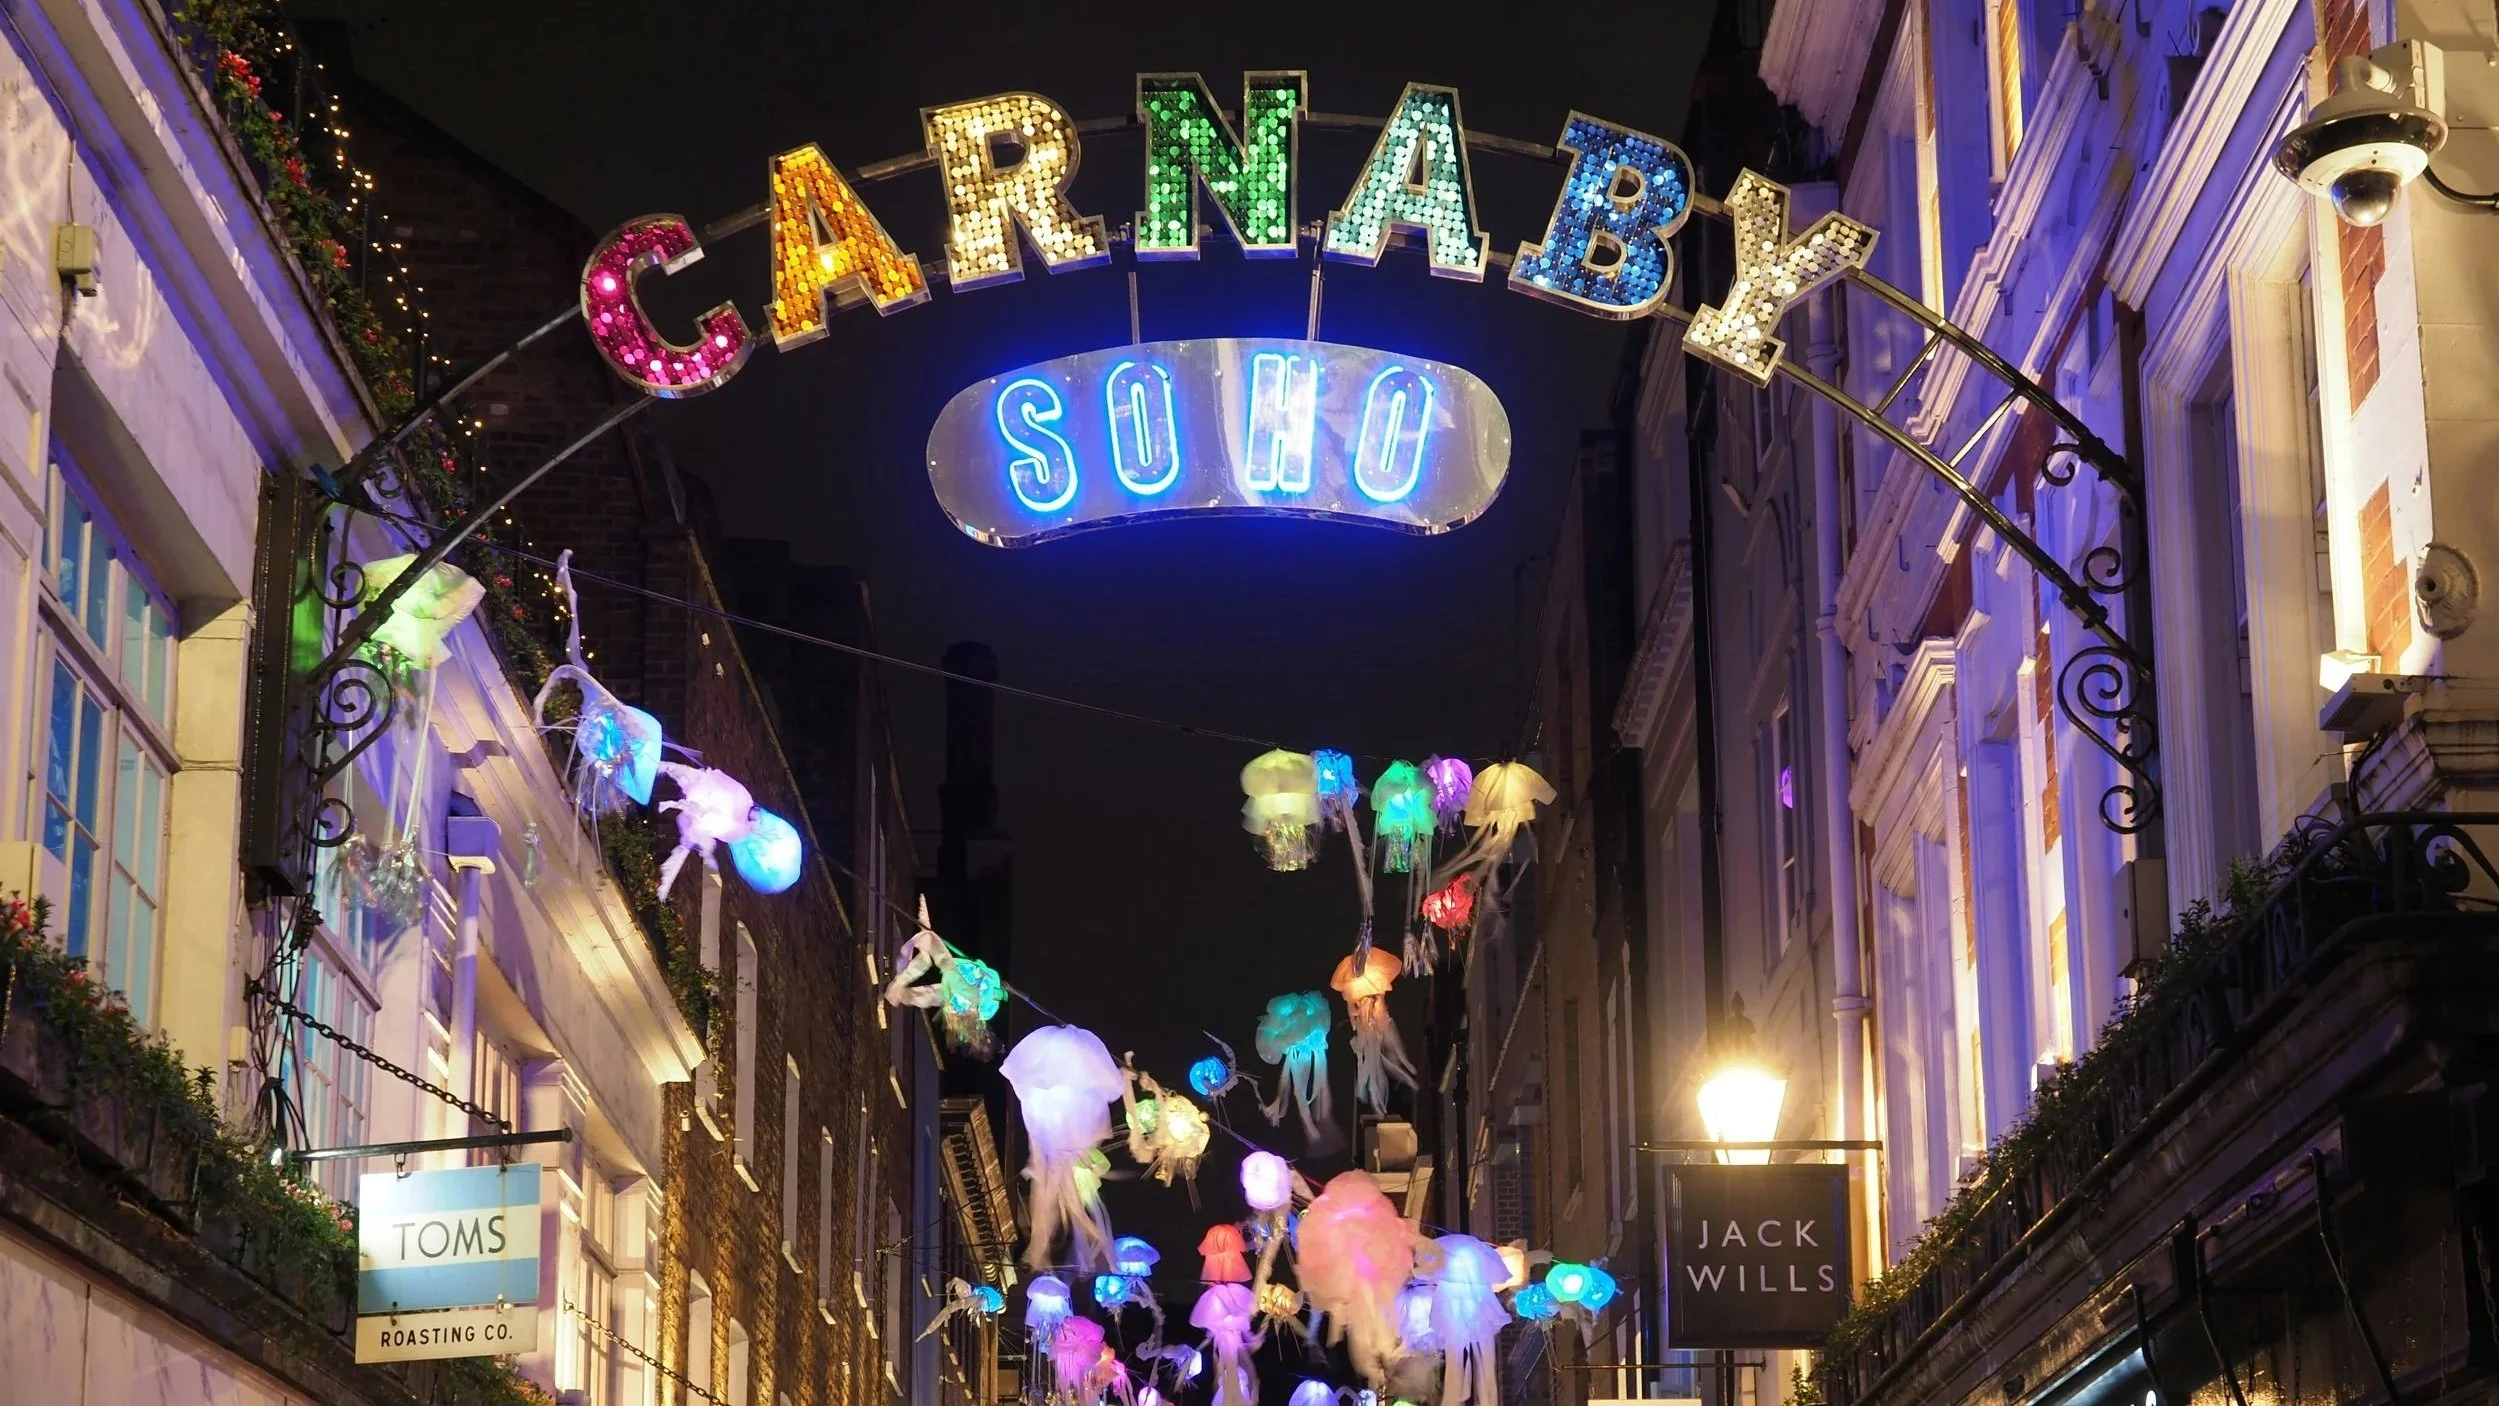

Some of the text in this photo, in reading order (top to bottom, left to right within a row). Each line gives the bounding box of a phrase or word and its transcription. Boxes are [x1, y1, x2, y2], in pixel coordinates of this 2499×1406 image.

[580, 70, 1880, 398] CARNABY
[997, 353, 1435, 512] SOHO
[392, 1215, 506, 1260] TOMS
[1698, 1220, 1819, 1249] JACK
[1686, 1264, 1835, 1293] WILLS
[380, 1323, 513, 1347] ROASTING CO.
